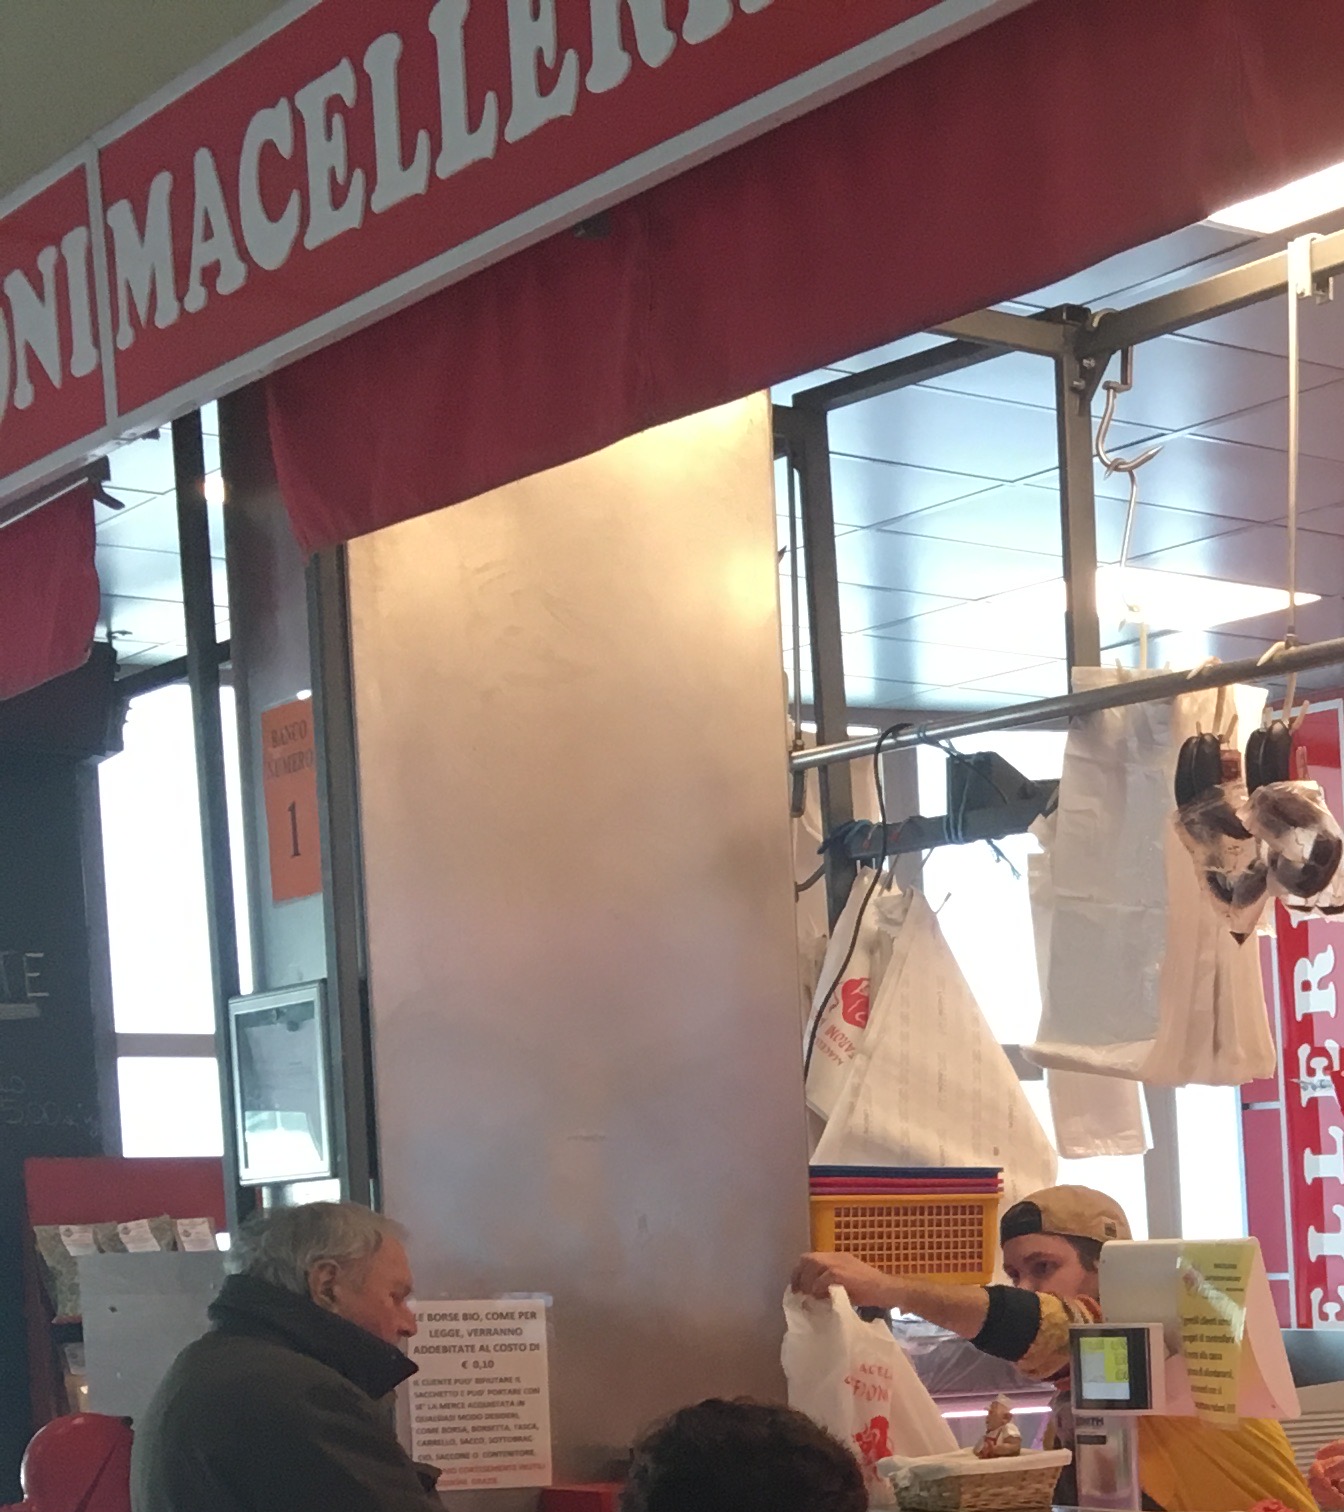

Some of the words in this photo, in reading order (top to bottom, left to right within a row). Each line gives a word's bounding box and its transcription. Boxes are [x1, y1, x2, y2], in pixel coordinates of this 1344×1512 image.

[0, 225, 99, 430] NI
[287, 800, 302, 859] 1
[427, 1313, 460, 1322] BORSE
[485, 1311, 515, 1320] COME
[518, 1311, 537, 1320] PER
[429, 1328, 464, 1339] LEGGE,
[466, 1327, 524, 1337] VERRANNO
[413, 1344, 476, 1354] ADDEBITATE
[478, 1344, 491, 1353] AL
[493, 1343, 527, 1353] COSTO
[529, 1342, 540, 1351] DI
